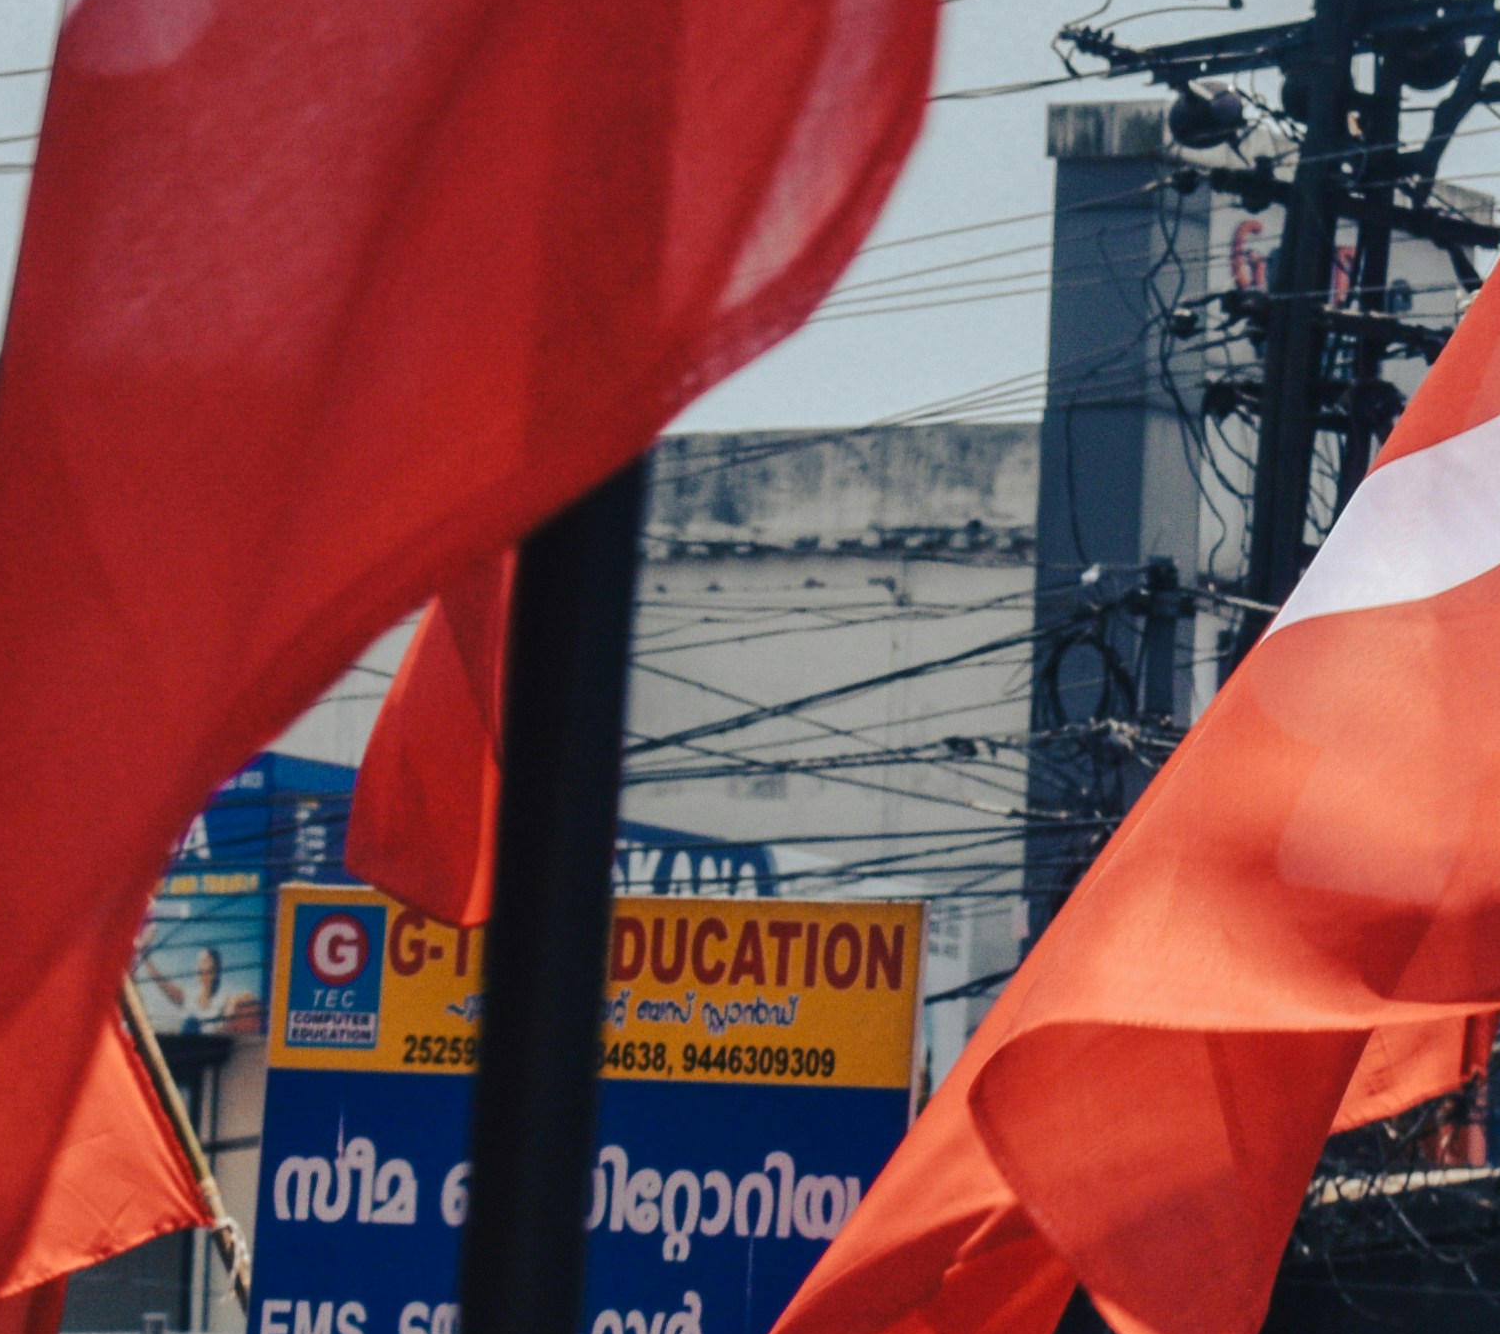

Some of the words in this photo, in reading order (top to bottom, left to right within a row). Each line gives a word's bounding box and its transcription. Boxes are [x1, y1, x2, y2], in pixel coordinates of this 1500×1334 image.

[314, 920, 360, 978] G
[610, 916, 906, 992] DUCATION
[313, 988, 357, 1009] TEC
[292, 1027, 372, 1042] EDUCATION
[293, 1011, 370, 1027] COMPUTER
[682, 1045, 835, 1078] 9446309309
[273, 1136, 418, 1226] സീമ
